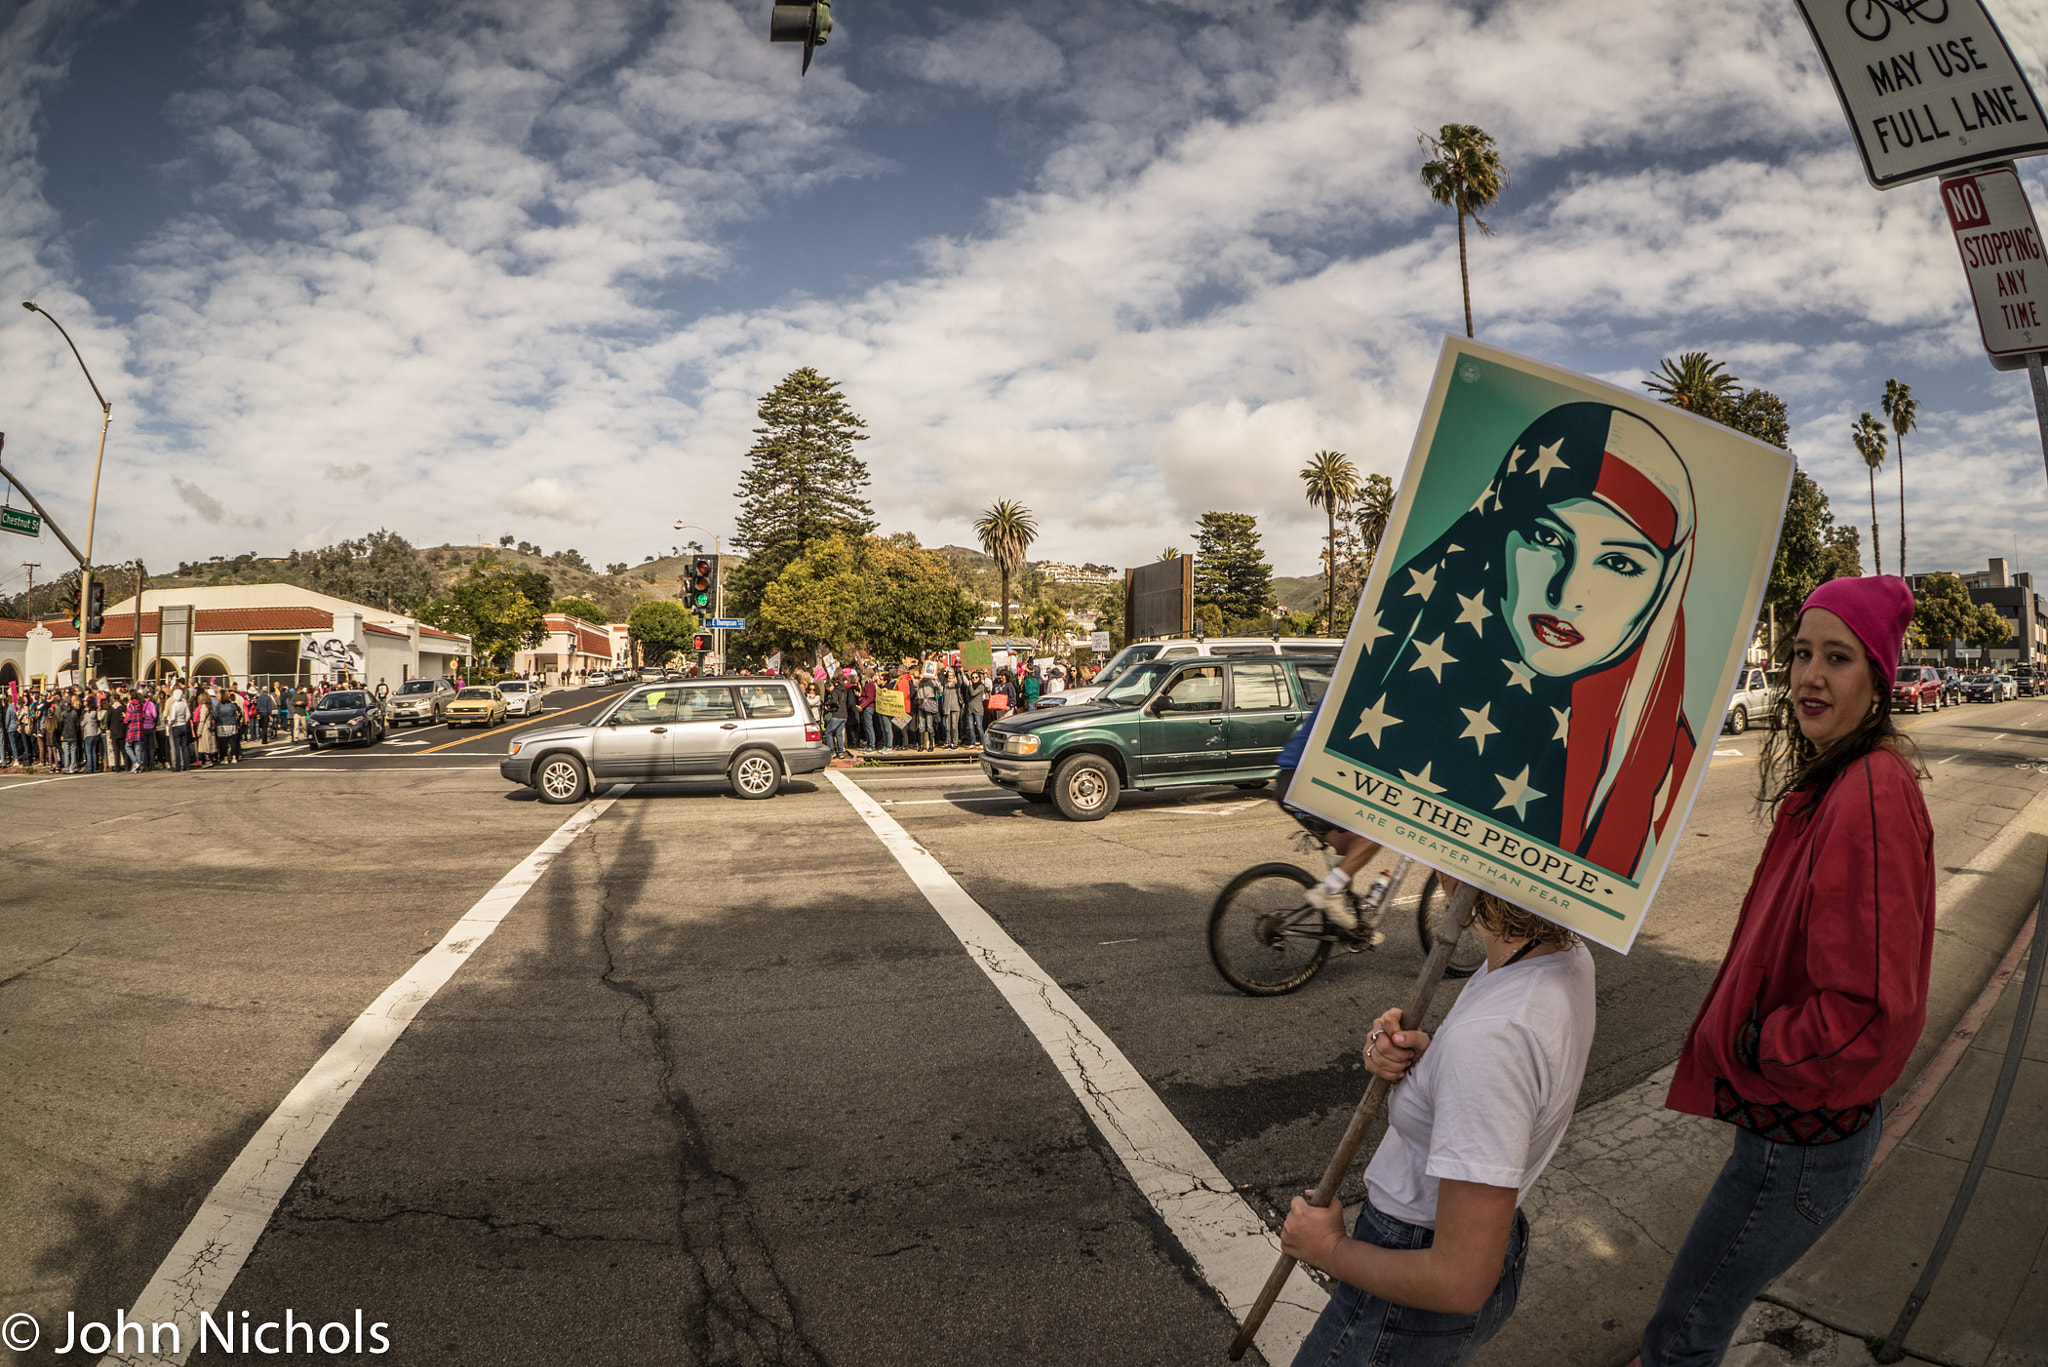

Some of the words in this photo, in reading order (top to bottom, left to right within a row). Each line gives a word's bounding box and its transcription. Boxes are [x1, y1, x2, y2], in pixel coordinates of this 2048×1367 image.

[1866, 51, 1922, 96] MAY
[1927, 36, 1988, 77] USE
[1872, 104, 1950, 153] FULL
[1951, 85, 2029, 132] LANE
[1947, 183, 1982, 223] NO
[1963, 227, 2040, 269] STOPPING
[1996, 269, 2028, 297] ANY
[2001, 301, 2041, 330] TIME
[3, 513, 31, 529] Chestnut
[31, 520, 39, 531] St
[717, 618, 737, 627] Thompson
[1353, 770, 1403, 807] WE
[1412, 796, 1473, 838] THE
[1479, 827, 1600, 894] PEOPLE
[1354, 809, 1387, 828] ARE
[1395, 826, 1470, 864] GREATER
[1478, 861, 1521, 887] THAN
[1528, 885, 1571, 910] FEAR
